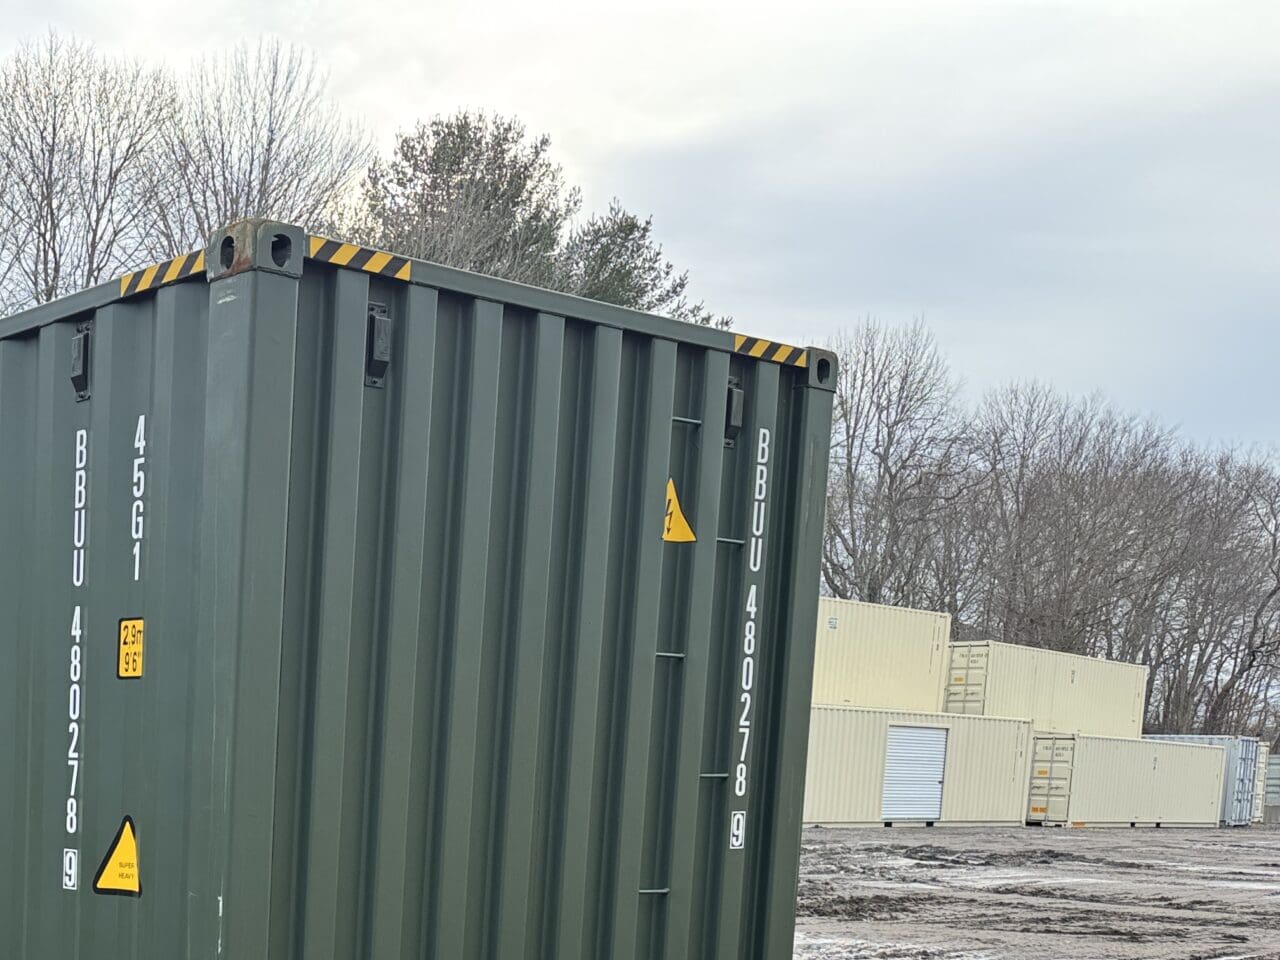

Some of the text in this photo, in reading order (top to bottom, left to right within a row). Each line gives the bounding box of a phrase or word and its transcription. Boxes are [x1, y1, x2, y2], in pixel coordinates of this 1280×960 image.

[64, 429, 87, 889] BBUU 480278 9
[131, 414, 146, 581] 45G1
[731, 428, 770, 848] BBUU 480278 9
